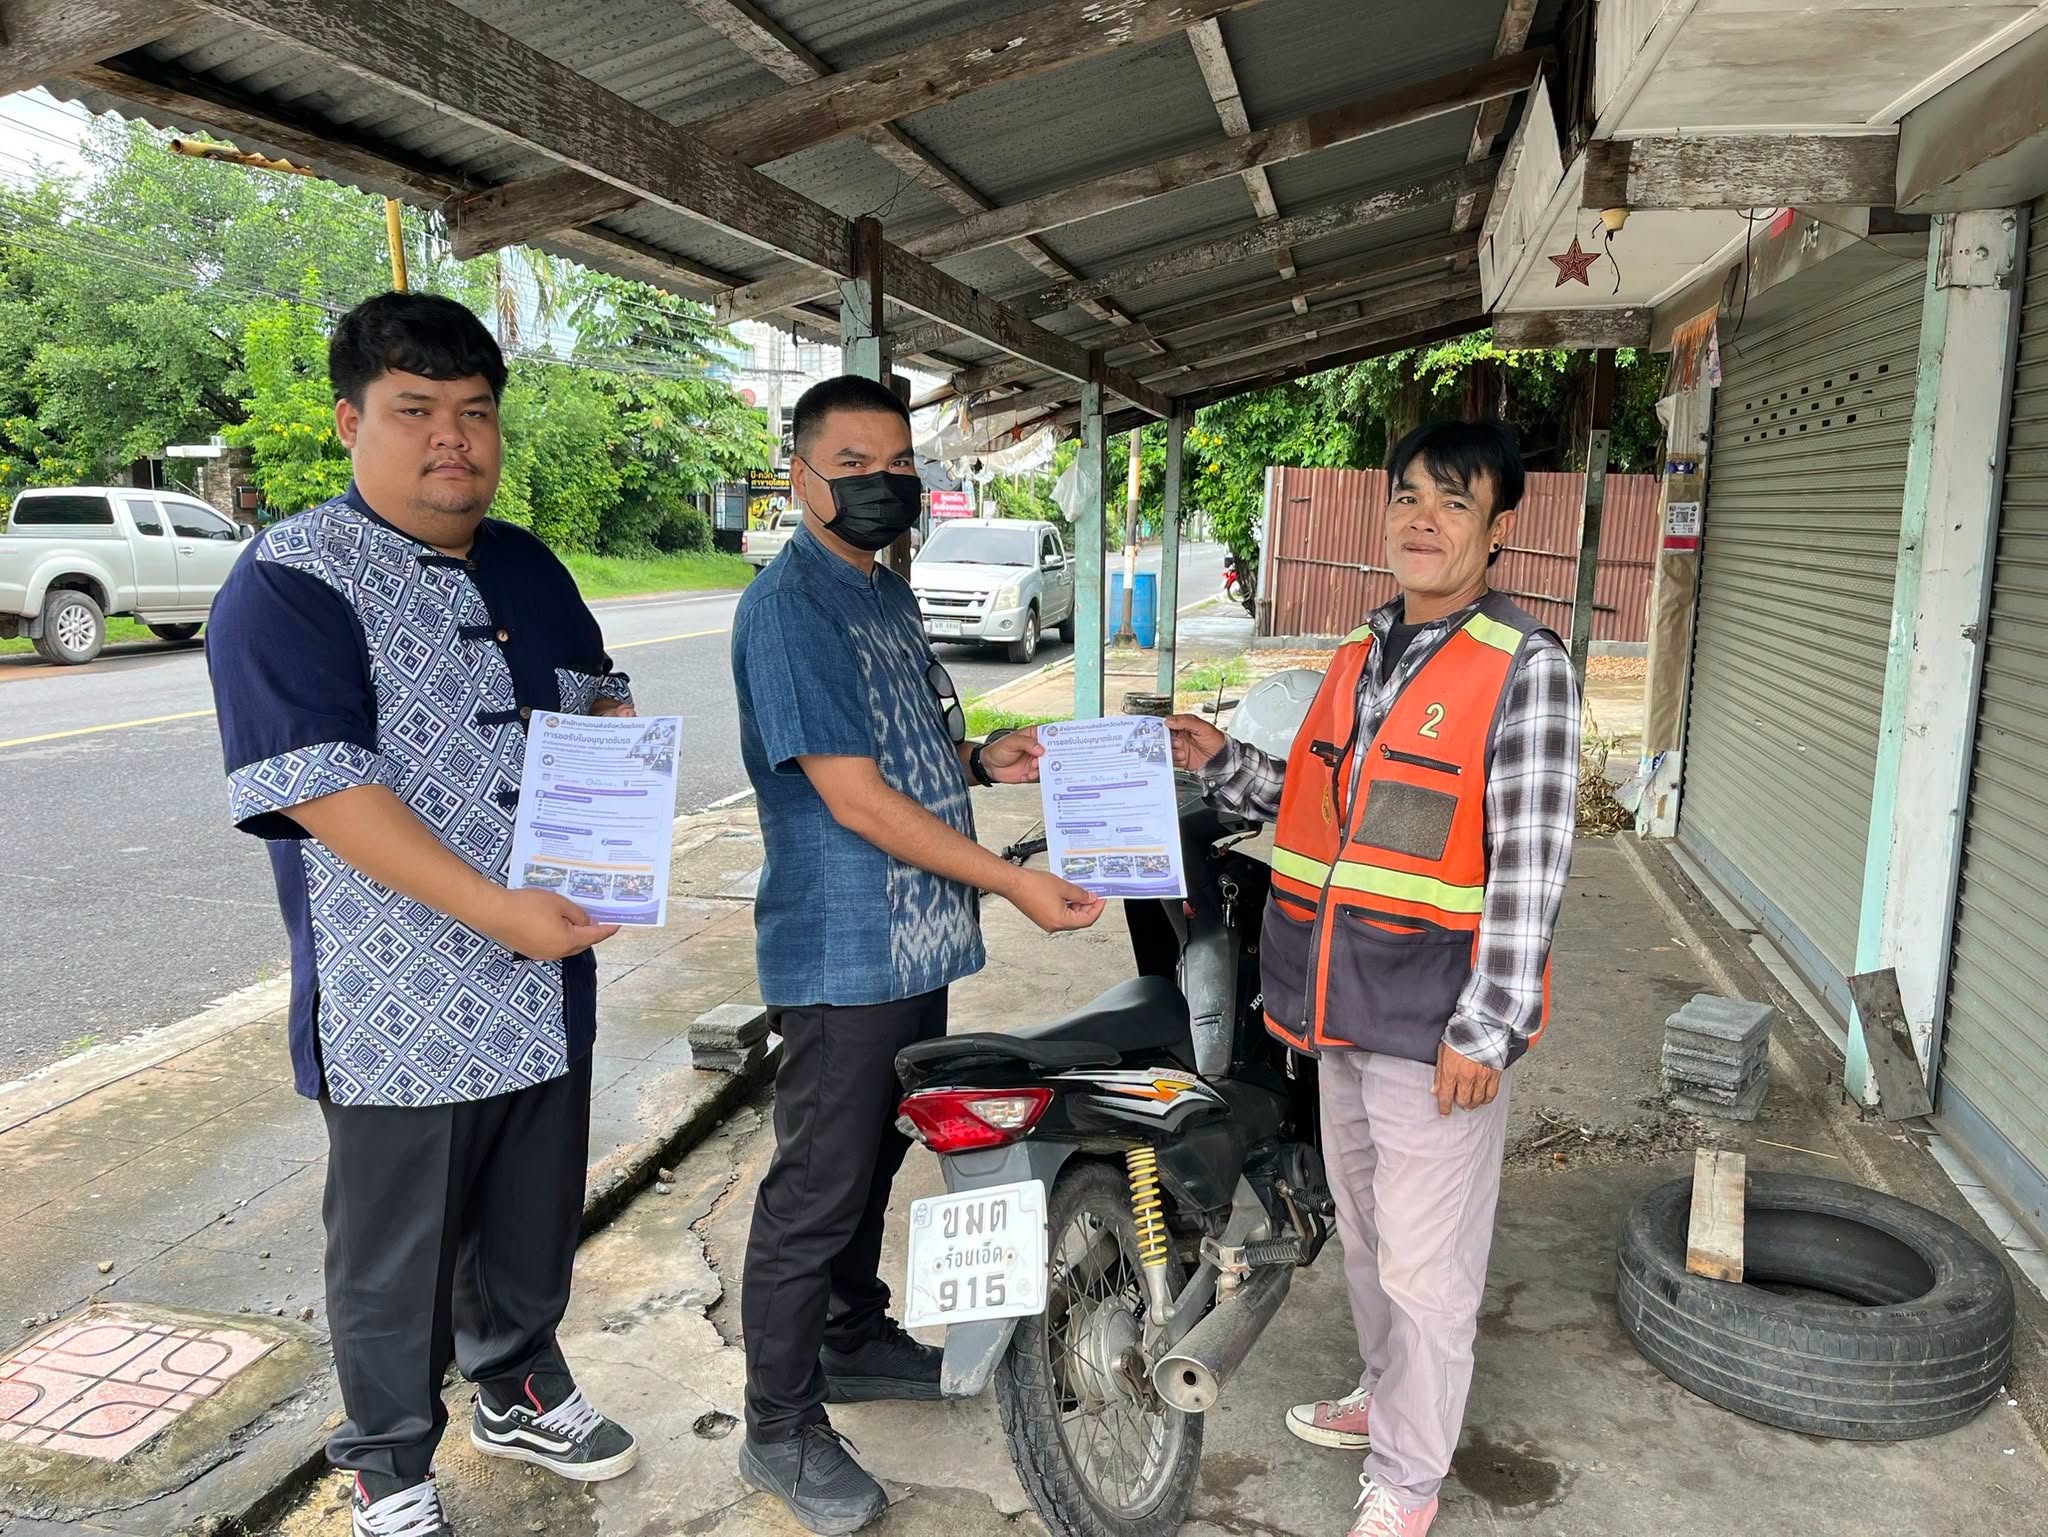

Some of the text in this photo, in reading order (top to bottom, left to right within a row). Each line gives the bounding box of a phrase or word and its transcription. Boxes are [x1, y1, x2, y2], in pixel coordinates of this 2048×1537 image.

[1416, 702, 1446, 740] 2
[942, 1199, 1008, 1239] ขมต
[944, 1240, 1003, 1270] ร้อยเอ็ด
[939, 1273, 1006, 1312] 915
